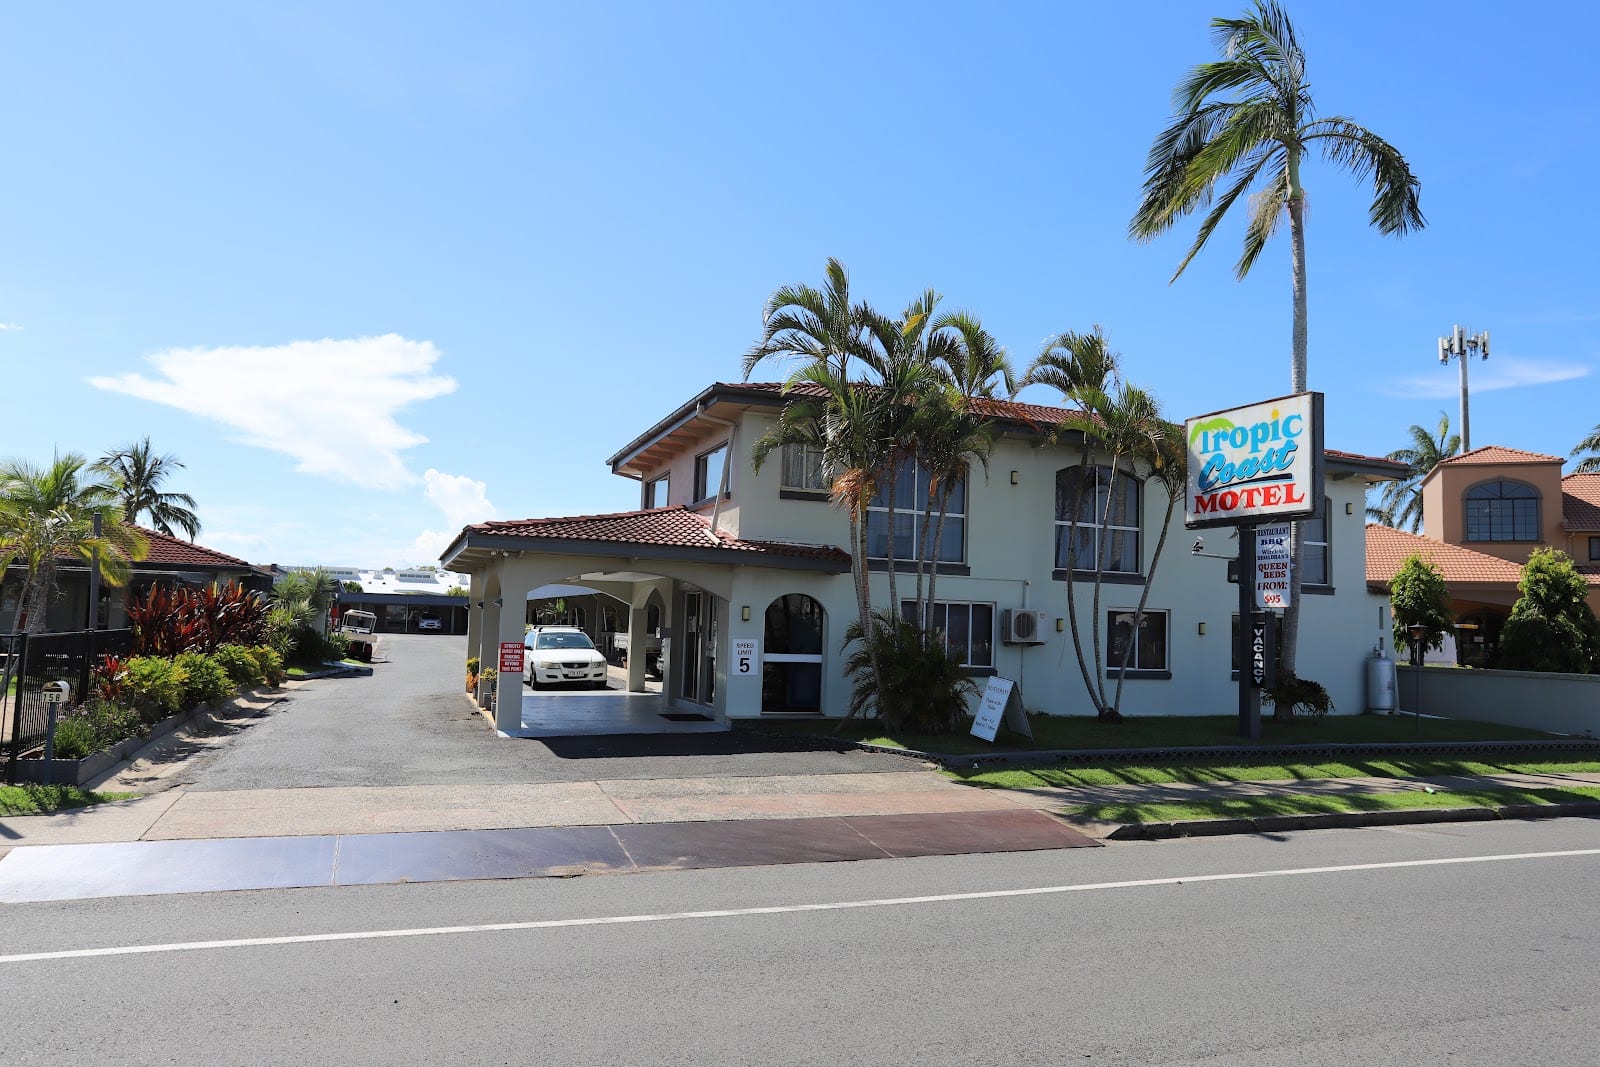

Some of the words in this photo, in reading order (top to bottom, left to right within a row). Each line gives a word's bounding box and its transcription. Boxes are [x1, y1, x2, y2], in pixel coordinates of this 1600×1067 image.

[1198, 408, 1303, 454] Tropic
[1198, 439, 1298, 491] Coast
[1194, 483, 1305, 514] MOTEL
[1257, 527, 1289, 536] RESTAURANT
[1260, 538, 1283, 546] BBQ
[1258, 562, 1288, 572] QUEEN
[1263, 571, 1286, 579] BEDS
[1257, 581, 1288, 590] FROM:
[1264, 594, 1281, 604] $95
[1253, 628, 1264, 684] VACANCY
[739, 657, 750, 673] 5
[43, 693, 60, 702] 158
